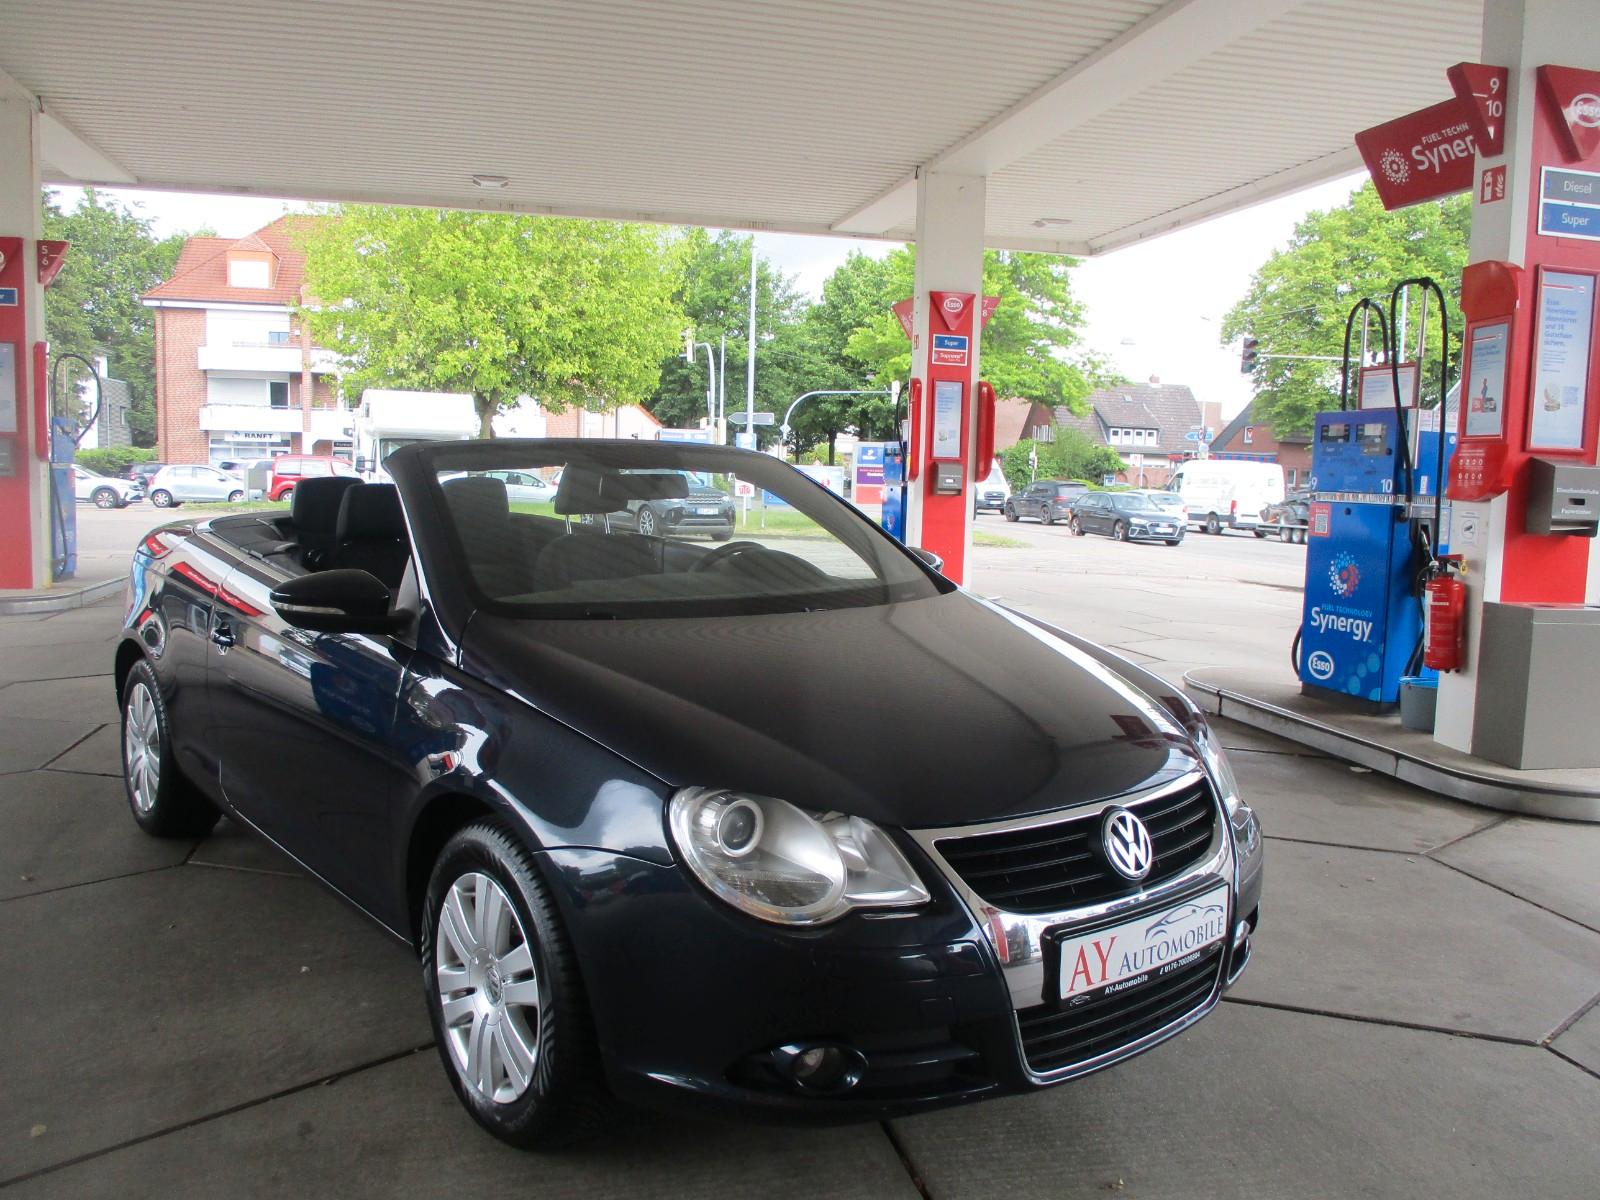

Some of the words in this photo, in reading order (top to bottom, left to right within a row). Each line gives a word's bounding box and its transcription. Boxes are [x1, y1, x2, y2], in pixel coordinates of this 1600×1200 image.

[1490, 78, 1500, 94] 9
[1486, 101, 1502, 117] 10
[1422, 132, 1441, 144] FUEL
[1563, 180, 1592, 194] Diesel
[1561, 212, 1590, 227] Super
[1311, 478, 1318, 491] 9
[1381, 479, 1393, 493] 10
[1310, 606, 1373, 641] Synergy
[1311, 658, 1331, 672] Esso
[1067, 935, 1117, 993] AY
[1118, 916, 1223, 976] AUTOMOBILE
[1104, 974, 1149, 996] AY-Automobile
